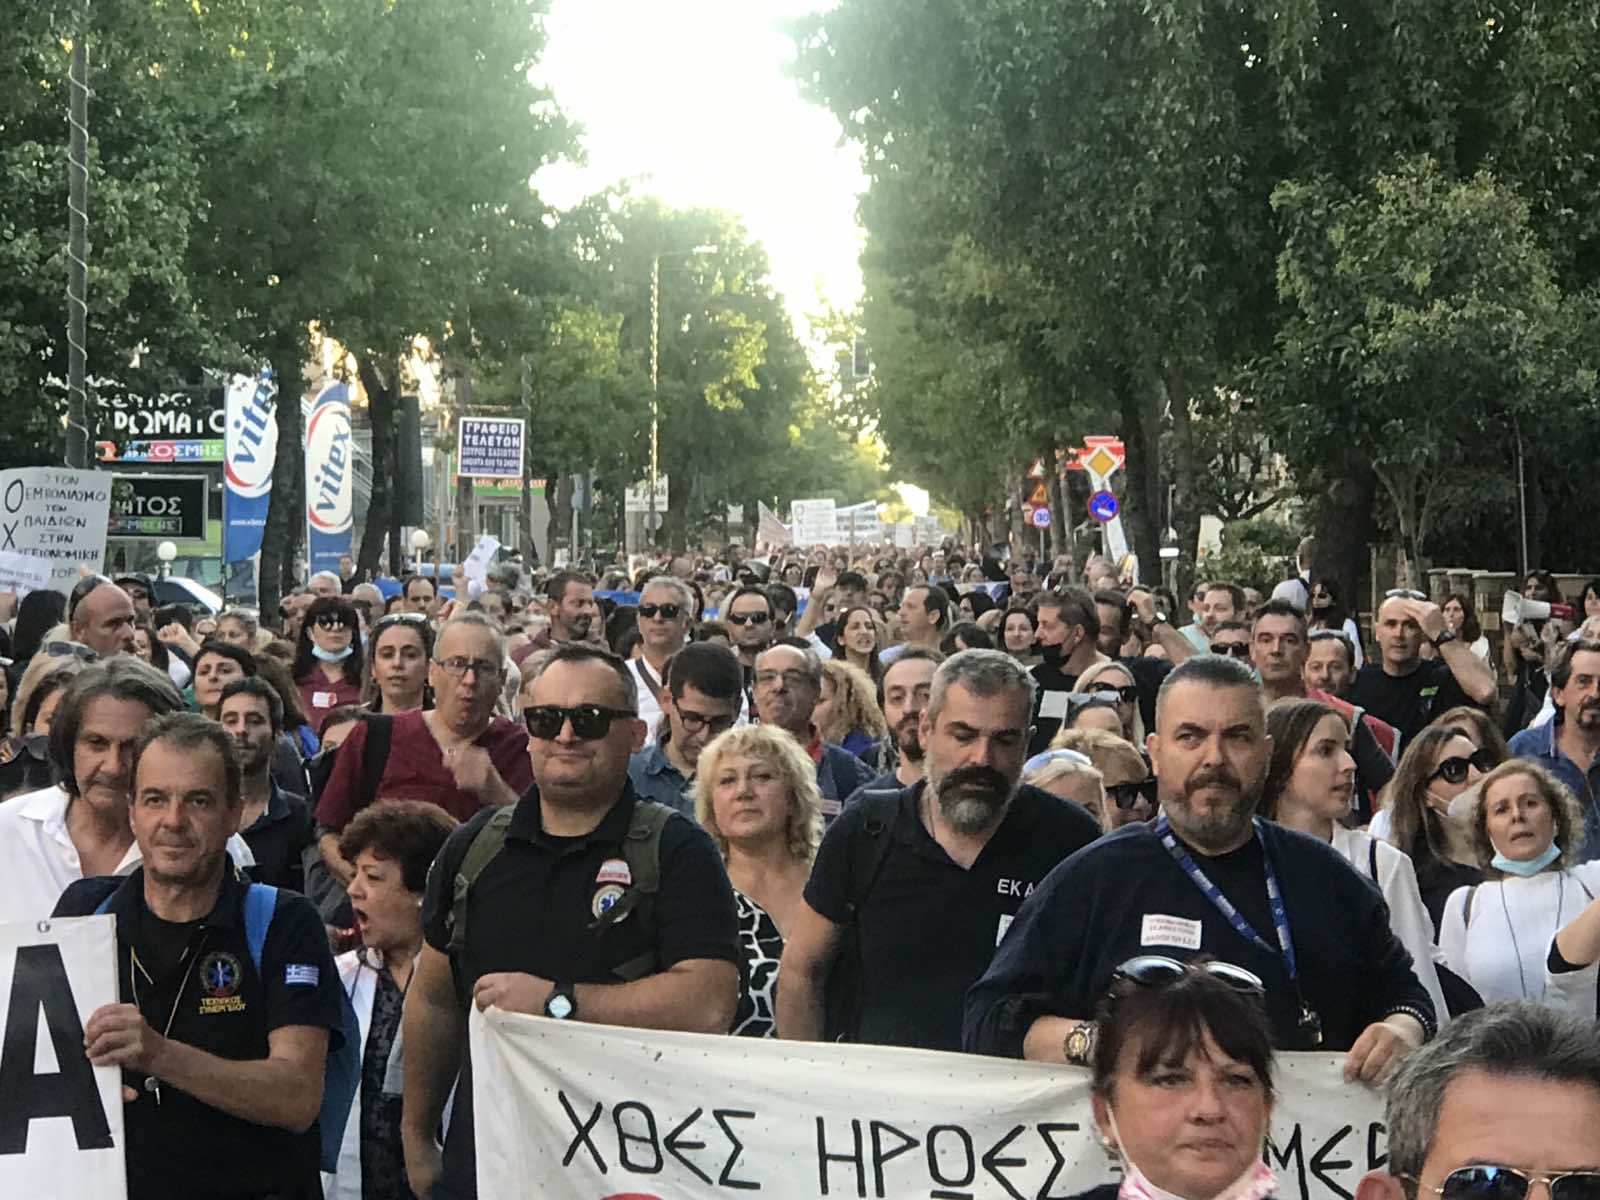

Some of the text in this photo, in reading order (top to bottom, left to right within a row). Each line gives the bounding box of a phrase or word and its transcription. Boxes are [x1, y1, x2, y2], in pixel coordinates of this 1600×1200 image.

[233, 366, 274, 465] vite
[464, 434, 520, 447] ΤΕΛΕΤΩΝ
[466, 422, 519, 435] ΓΡΑΦΕΙΟ
[315, 424, 350, 511] vitex
[1035, 511, 1050, 522] 30
[0, 943, 116, 1155] Α
[557, 1090, 761, 1190] ΧΘΕΣ
